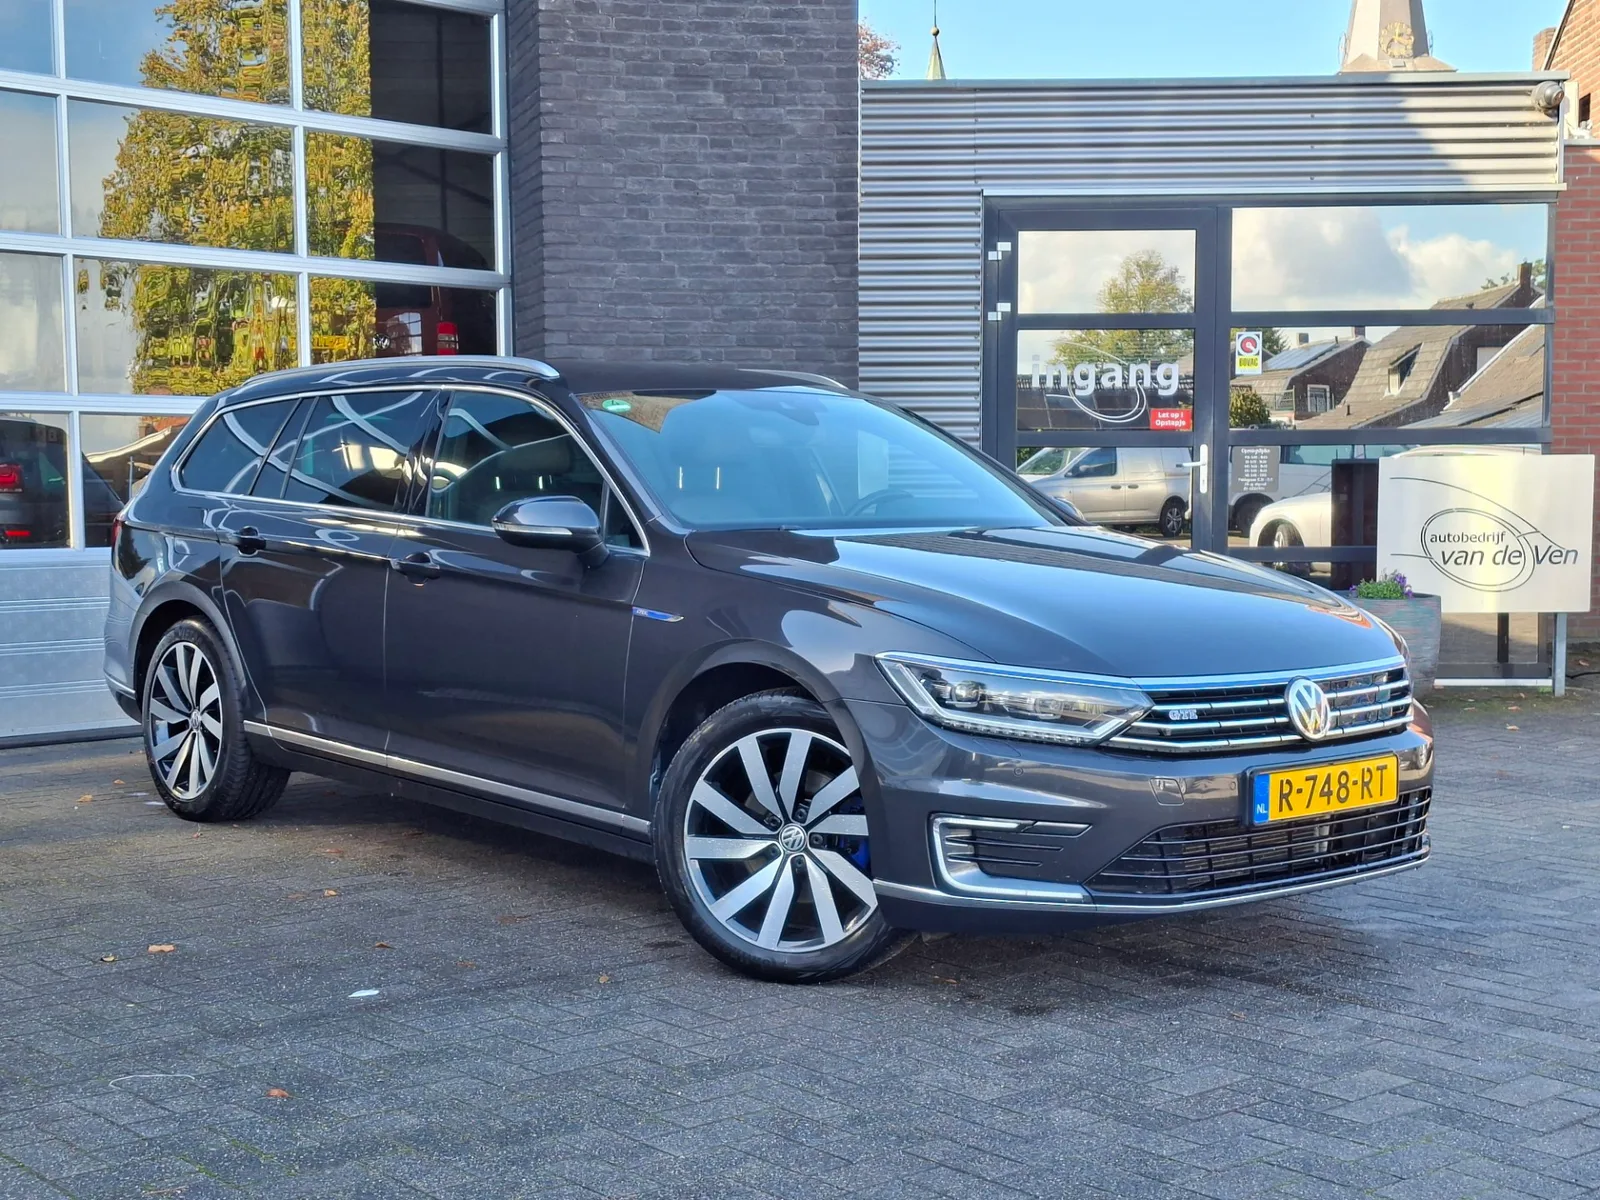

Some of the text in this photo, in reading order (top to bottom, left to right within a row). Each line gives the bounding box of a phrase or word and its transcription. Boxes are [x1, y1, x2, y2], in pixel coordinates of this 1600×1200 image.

[1031, 354, 1179, 395] ingang
[1155, 419, 1186, 427] Opstapje
[1430, 531, 1506, 545] autobedrijf
[1441, 545, 1578, 565] van de Ven
[1169, 709, 1198, 720] GTE
[1278, 765, 1388, 813] R-748-RT
[1256, 803, 1267, 815] NL
